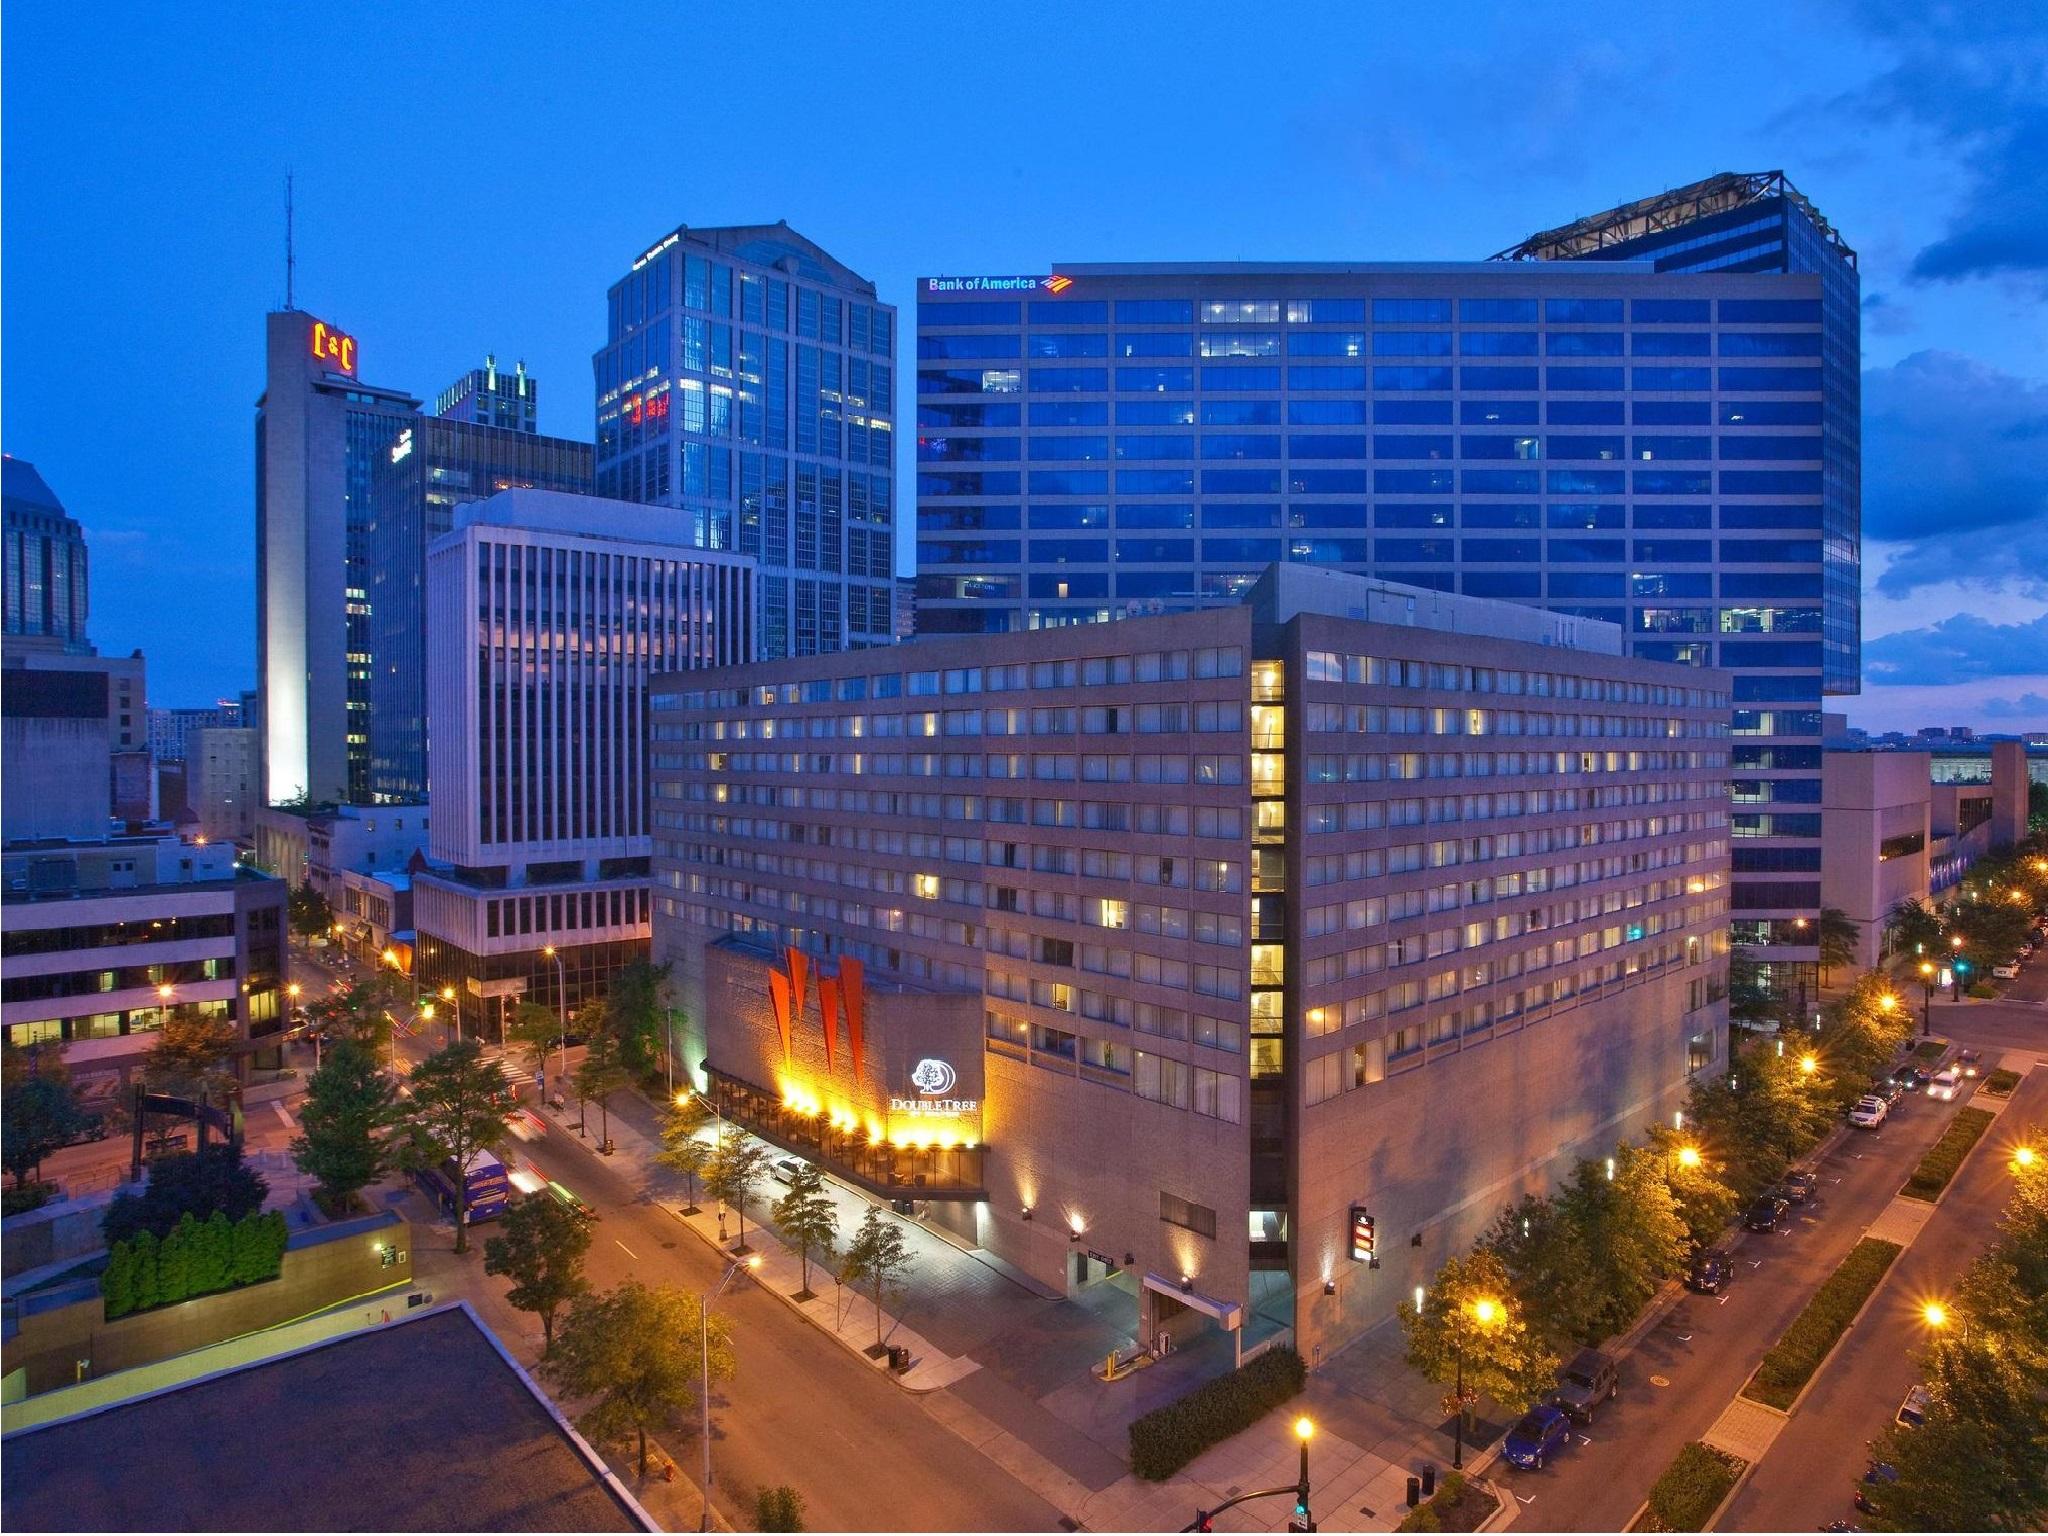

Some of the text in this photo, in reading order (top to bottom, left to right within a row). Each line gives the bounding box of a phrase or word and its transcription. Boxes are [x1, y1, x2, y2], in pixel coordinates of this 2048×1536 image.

[929, 277, 1036, 290] Bank of America
